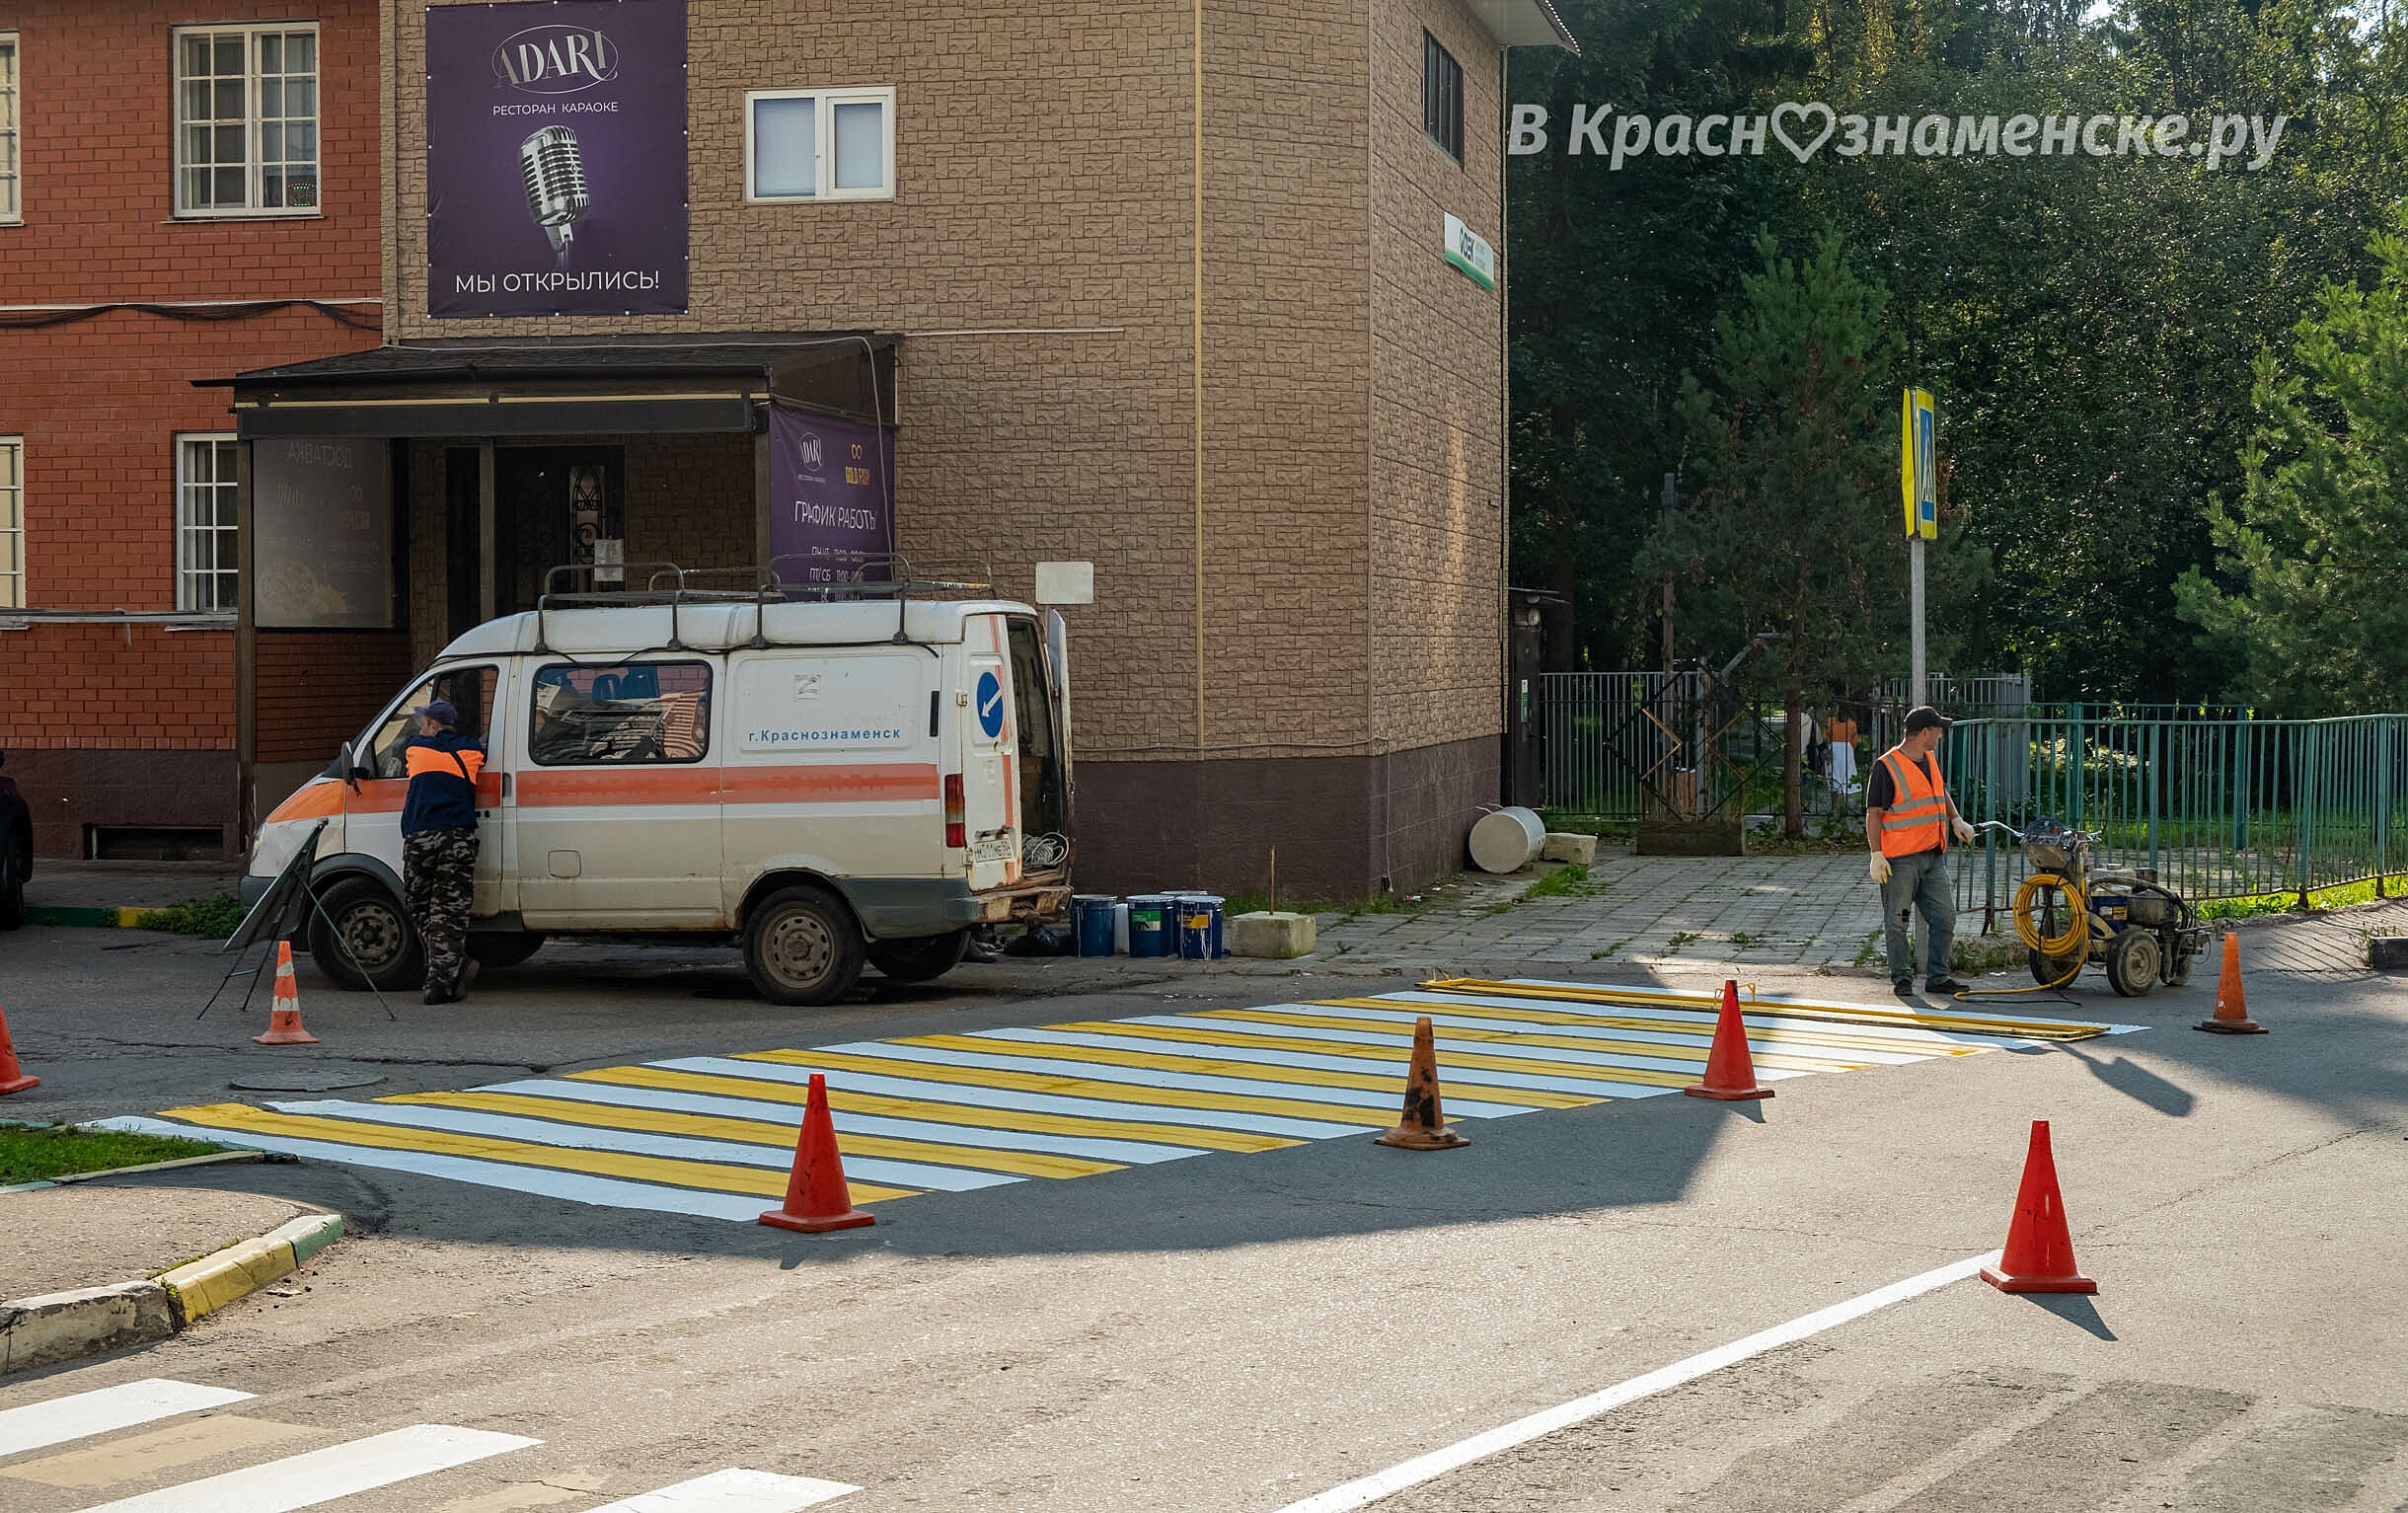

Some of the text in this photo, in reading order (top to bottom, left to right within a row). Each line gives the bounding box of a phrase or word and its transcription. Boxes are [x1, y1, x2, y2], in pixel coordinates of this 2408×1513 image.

[494, 31, 618, 88] ADARI
[493, 101, 619, 116] РЕСТОРАН КАРАОКЕ
[456, 269, 659, 293] МЫ ОТКРЫЛИСЬ!
[794, 500, 877, 530] ГРАФИК РАБОТЫ
[748, 729, 901, 743] г.Краснознаменск
